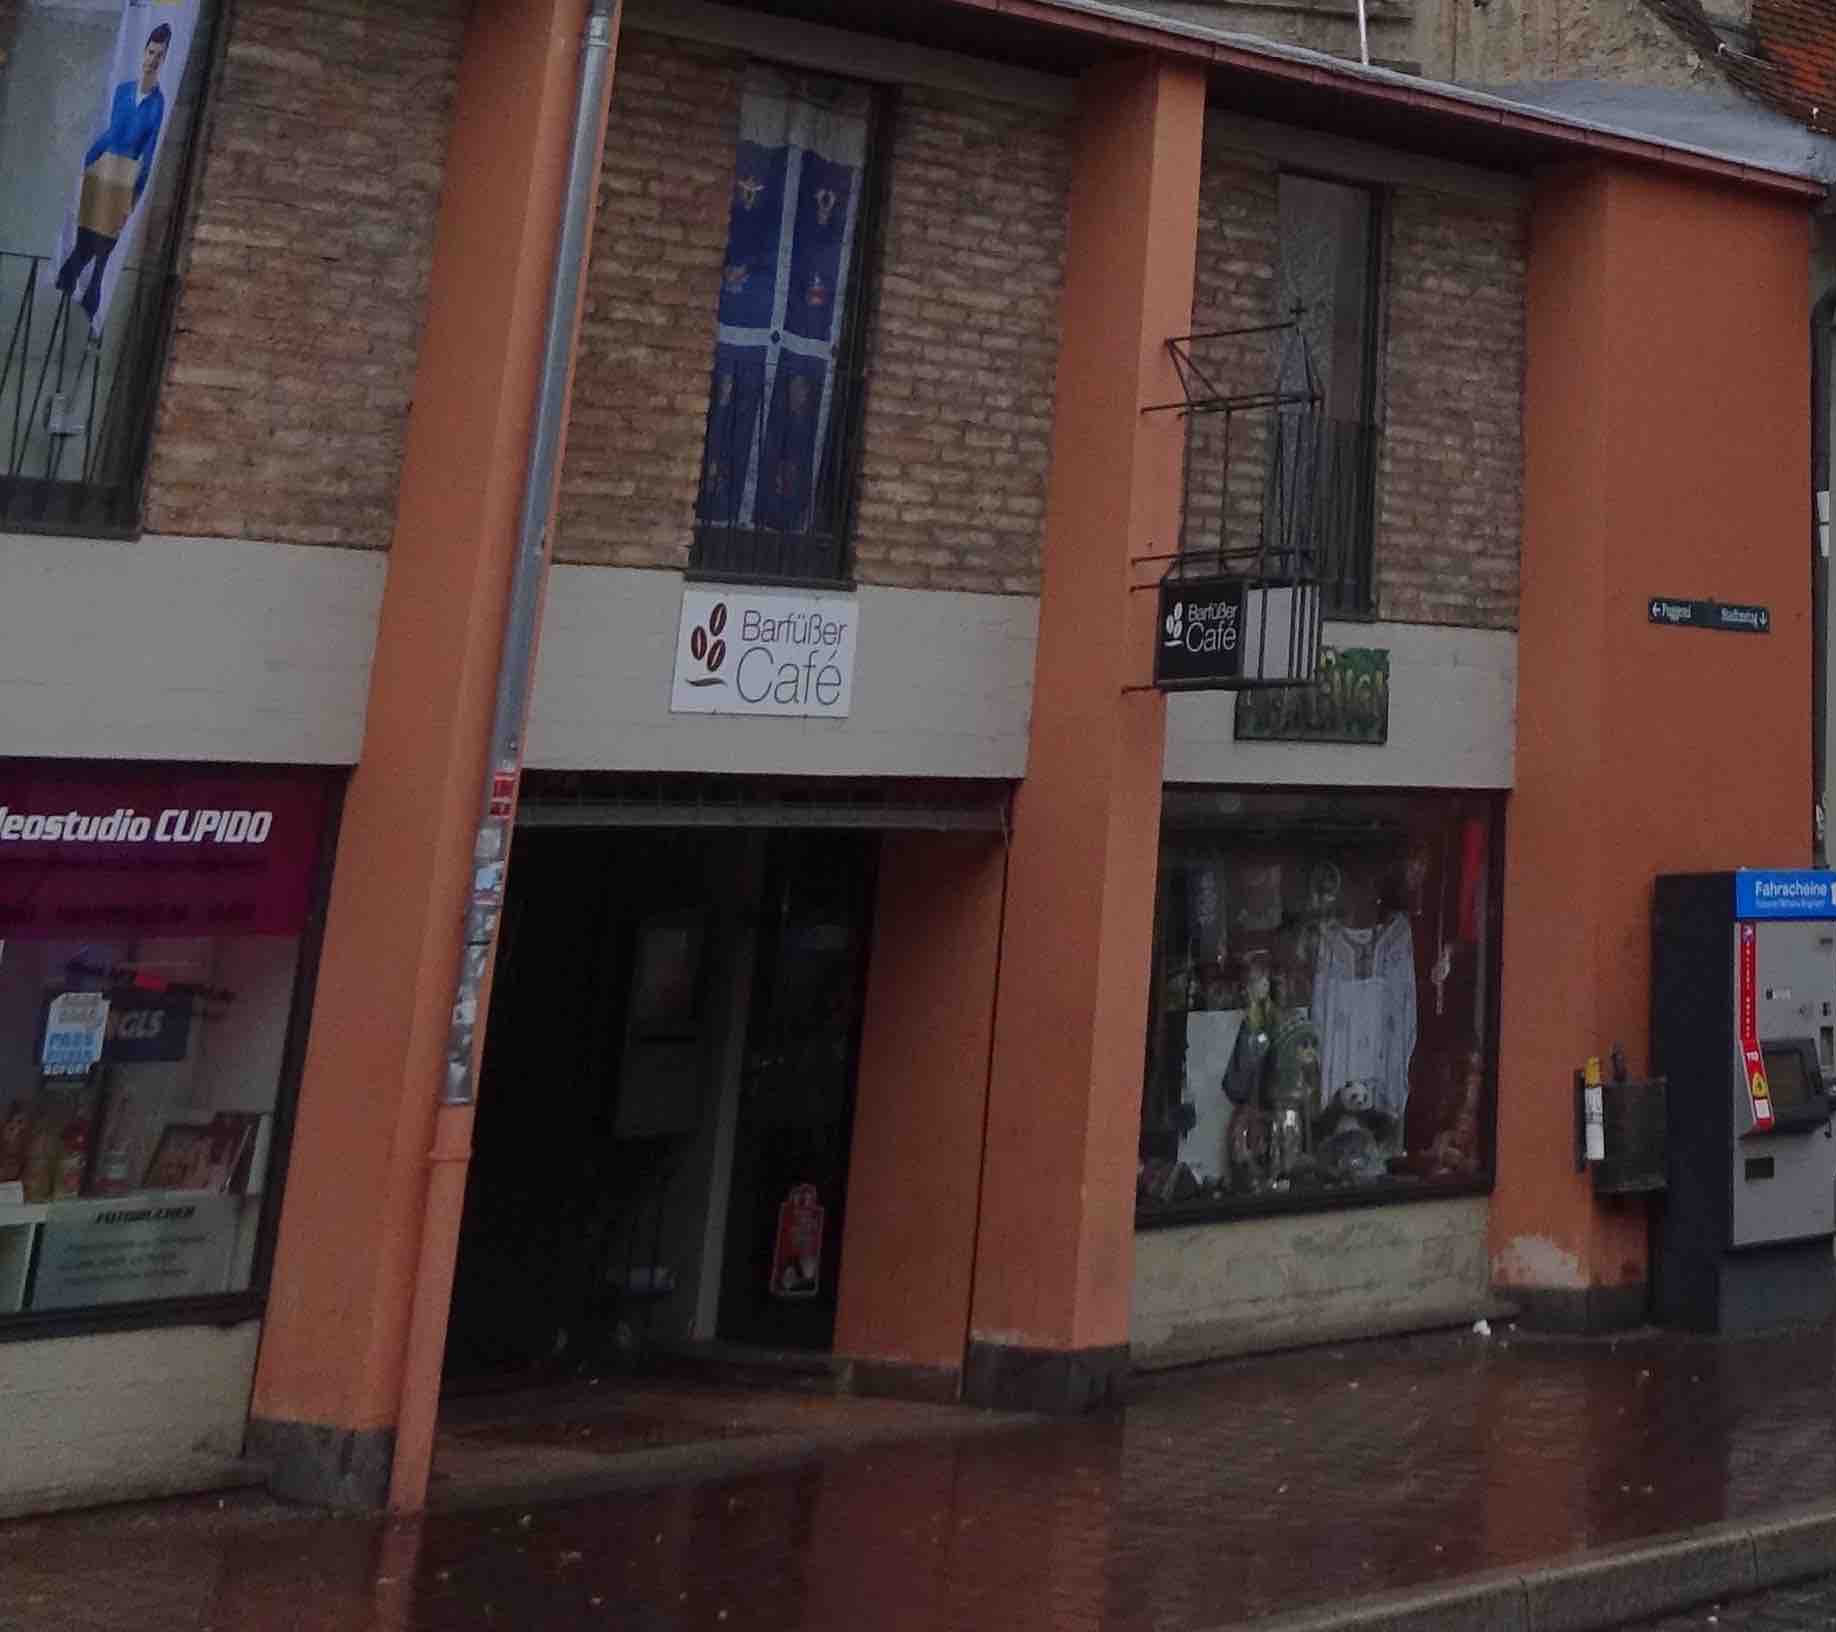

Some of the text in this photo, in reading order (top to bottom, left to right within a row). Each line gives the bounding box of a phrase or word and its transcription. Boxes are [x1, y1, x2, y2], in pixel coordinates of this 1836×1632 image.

[1189, 602, 1237, 621] Barfüßer
[741, 609, 848, 646] Barfüßer
[1187, 621, 1237, 652] Café
[736, 646, 842, 706] Café
[154, 809, 272, 843] CUPIDO
[1755, 879, 1828, 897] Fahrscheine
[118, 1009, 165, 1040] GLS
